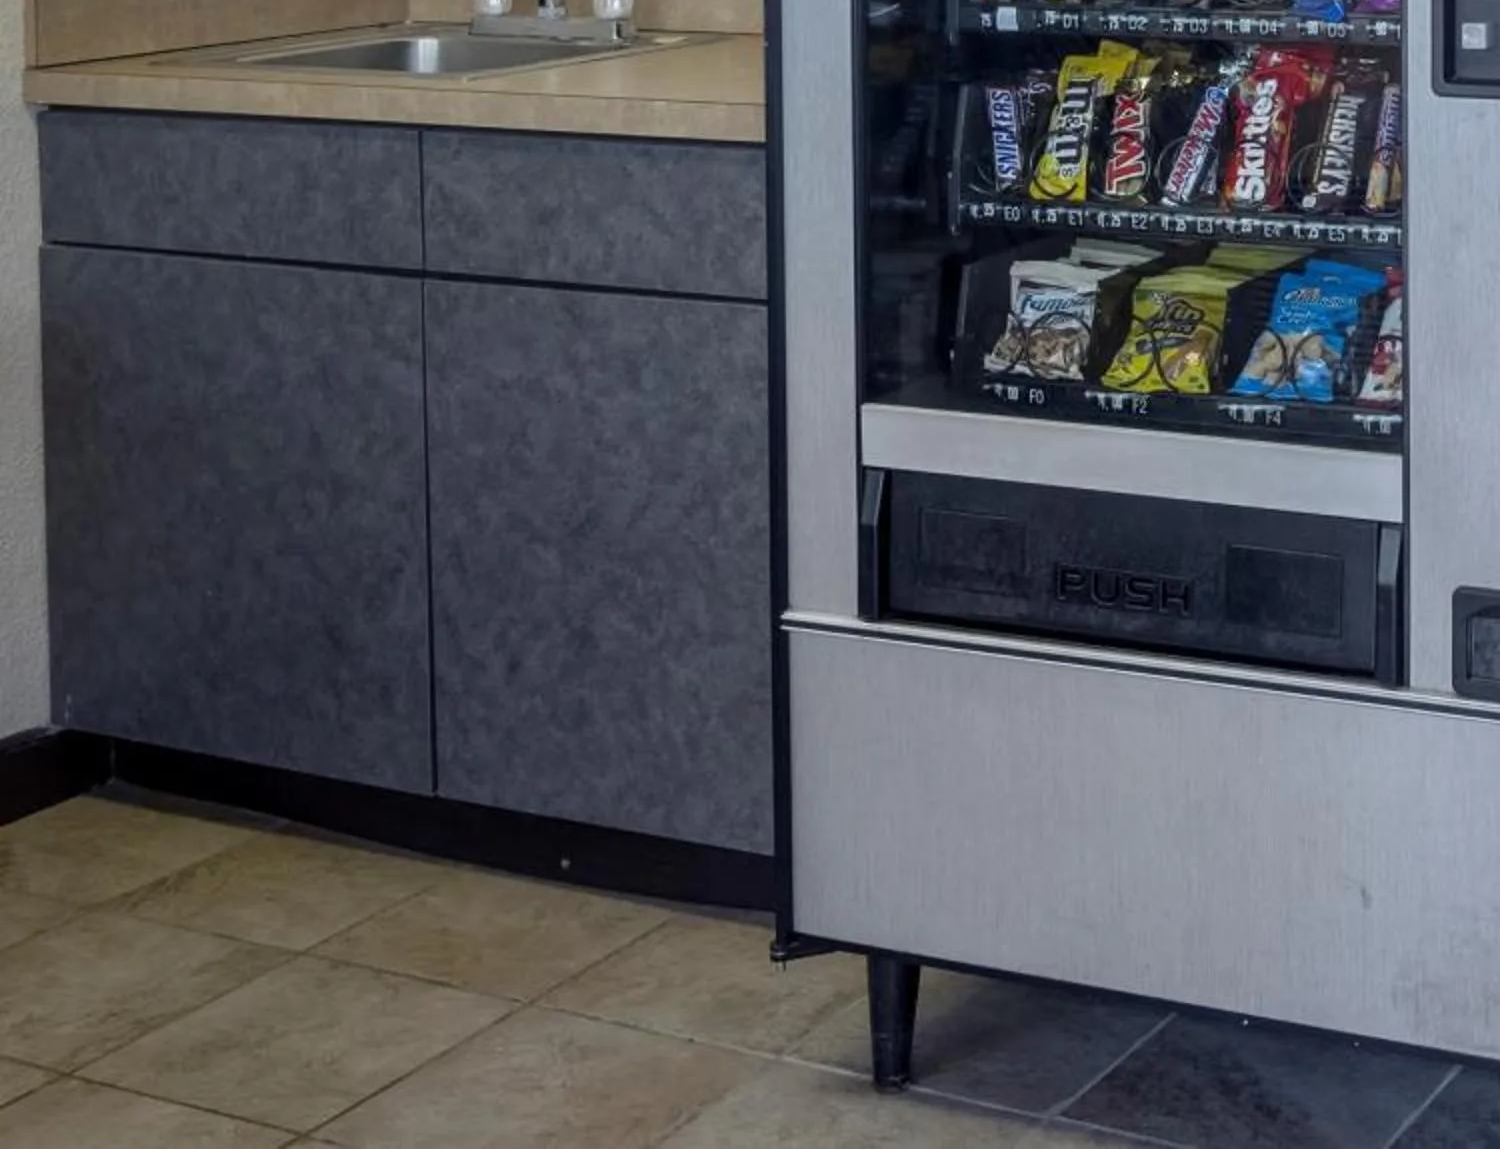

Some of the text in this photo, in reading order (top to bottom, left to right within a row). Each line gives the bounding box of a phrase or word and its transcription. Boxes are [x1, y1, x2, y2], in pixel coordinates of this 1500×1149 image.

[991, 90, 1021, 180] SNICKERS
[1234, 78, 1278, 201] Skittles
[1055, 562, 1196, 617] PUSH
